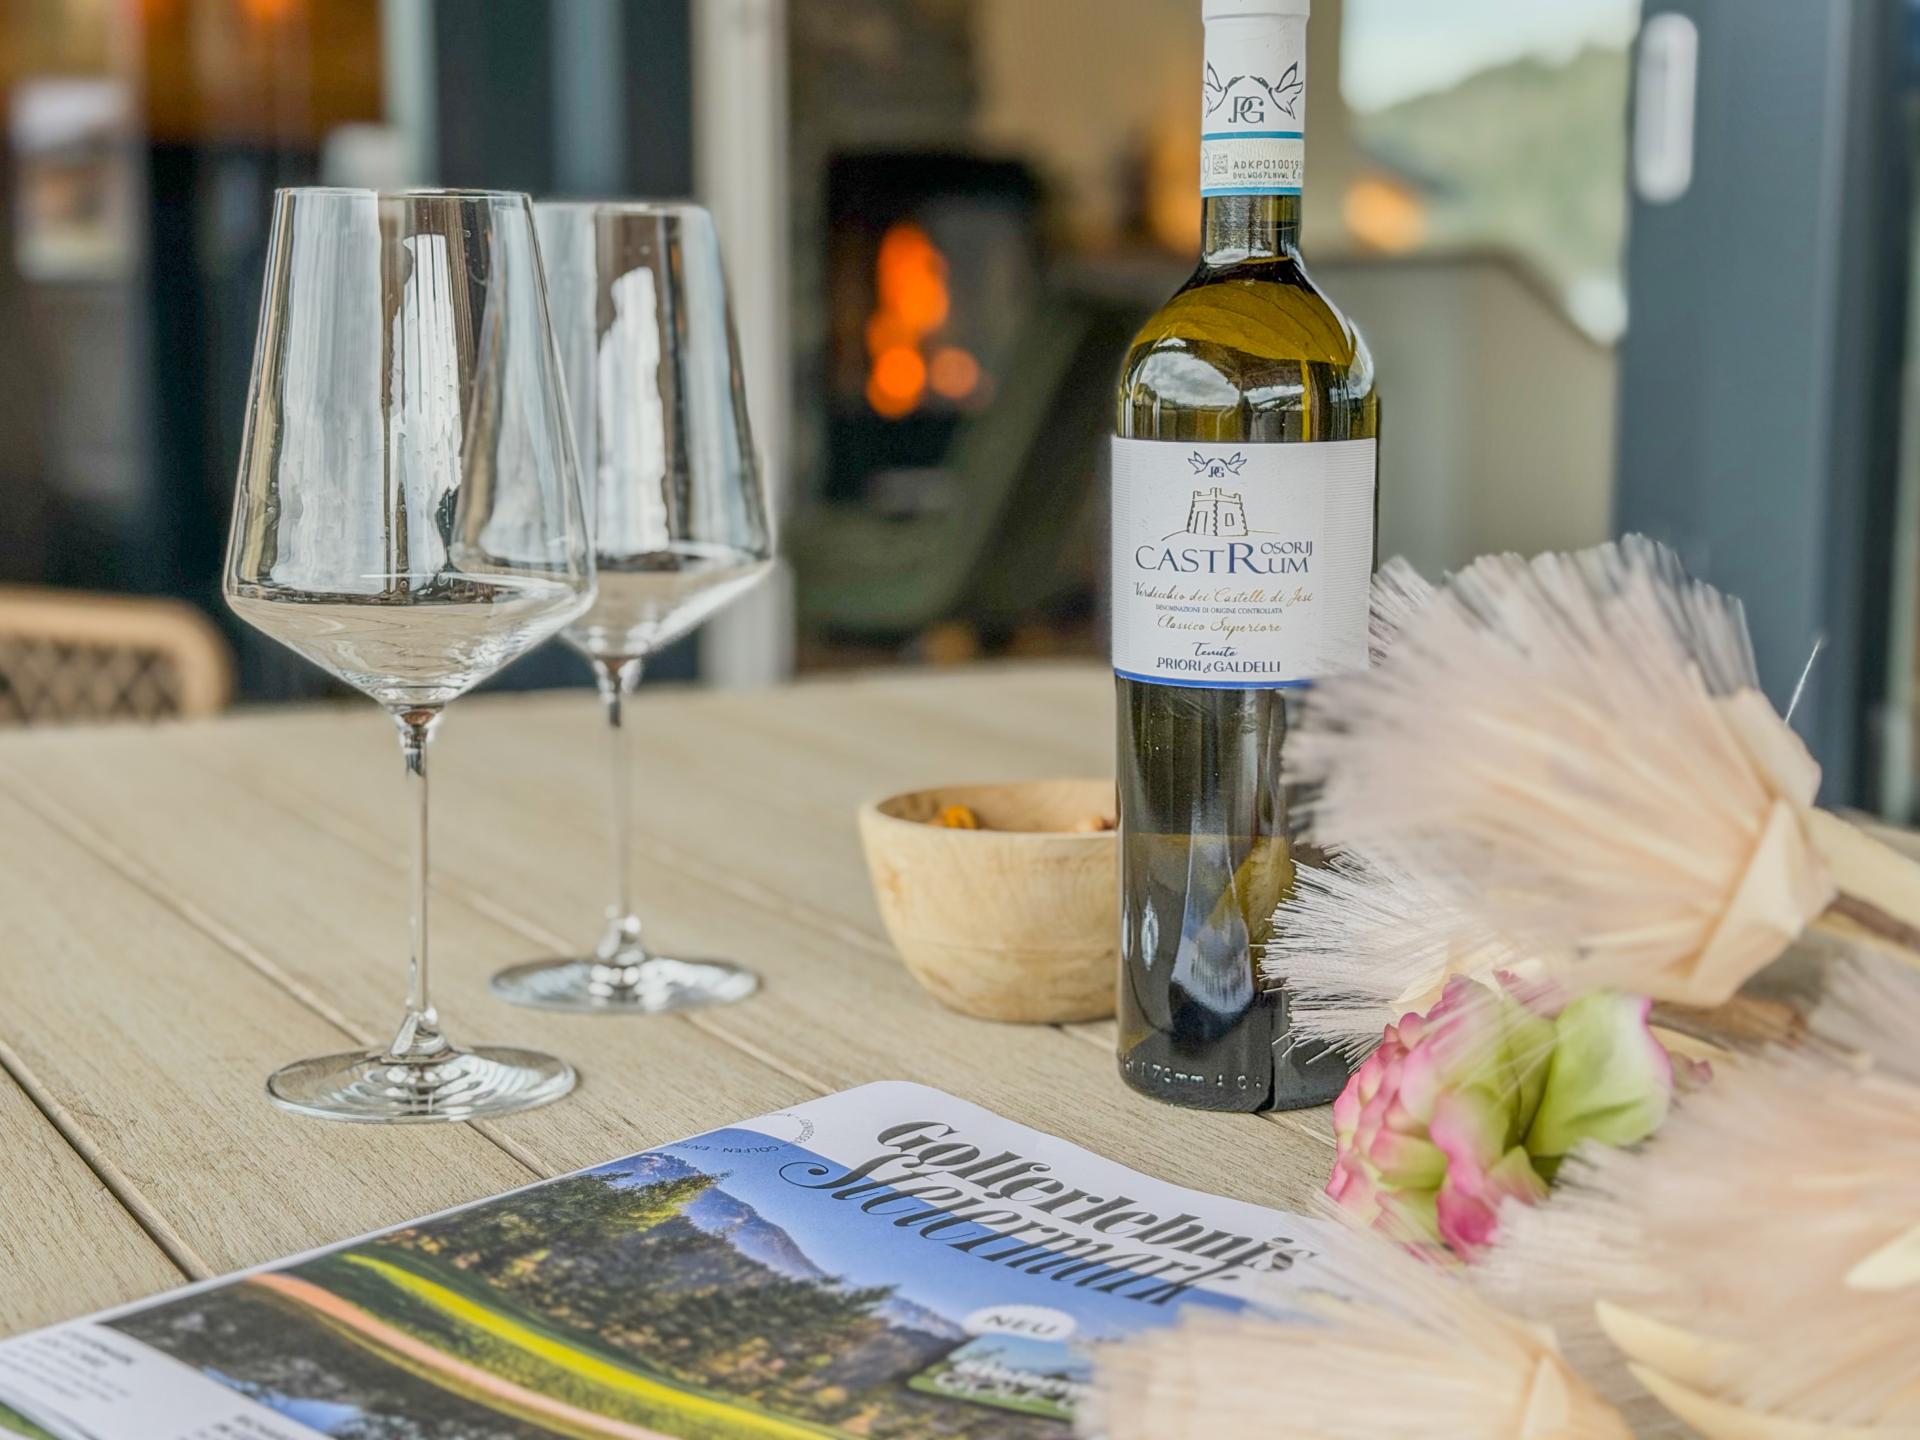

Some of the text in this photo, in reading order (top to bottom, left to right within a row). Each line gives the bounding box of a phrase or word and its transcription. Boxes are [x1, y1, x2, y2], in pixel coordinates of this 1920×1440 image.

[1189, 588, 1210, 601] dei
[1214, 587, 1265, 603] Castelli
[1270, 589, 1285, 602] di
[1157, 613, 1281, 640] Classico Superiore
[1192, 642, 1237, 657] Tenute
[986, 1315, 1057, 1335] NEU
